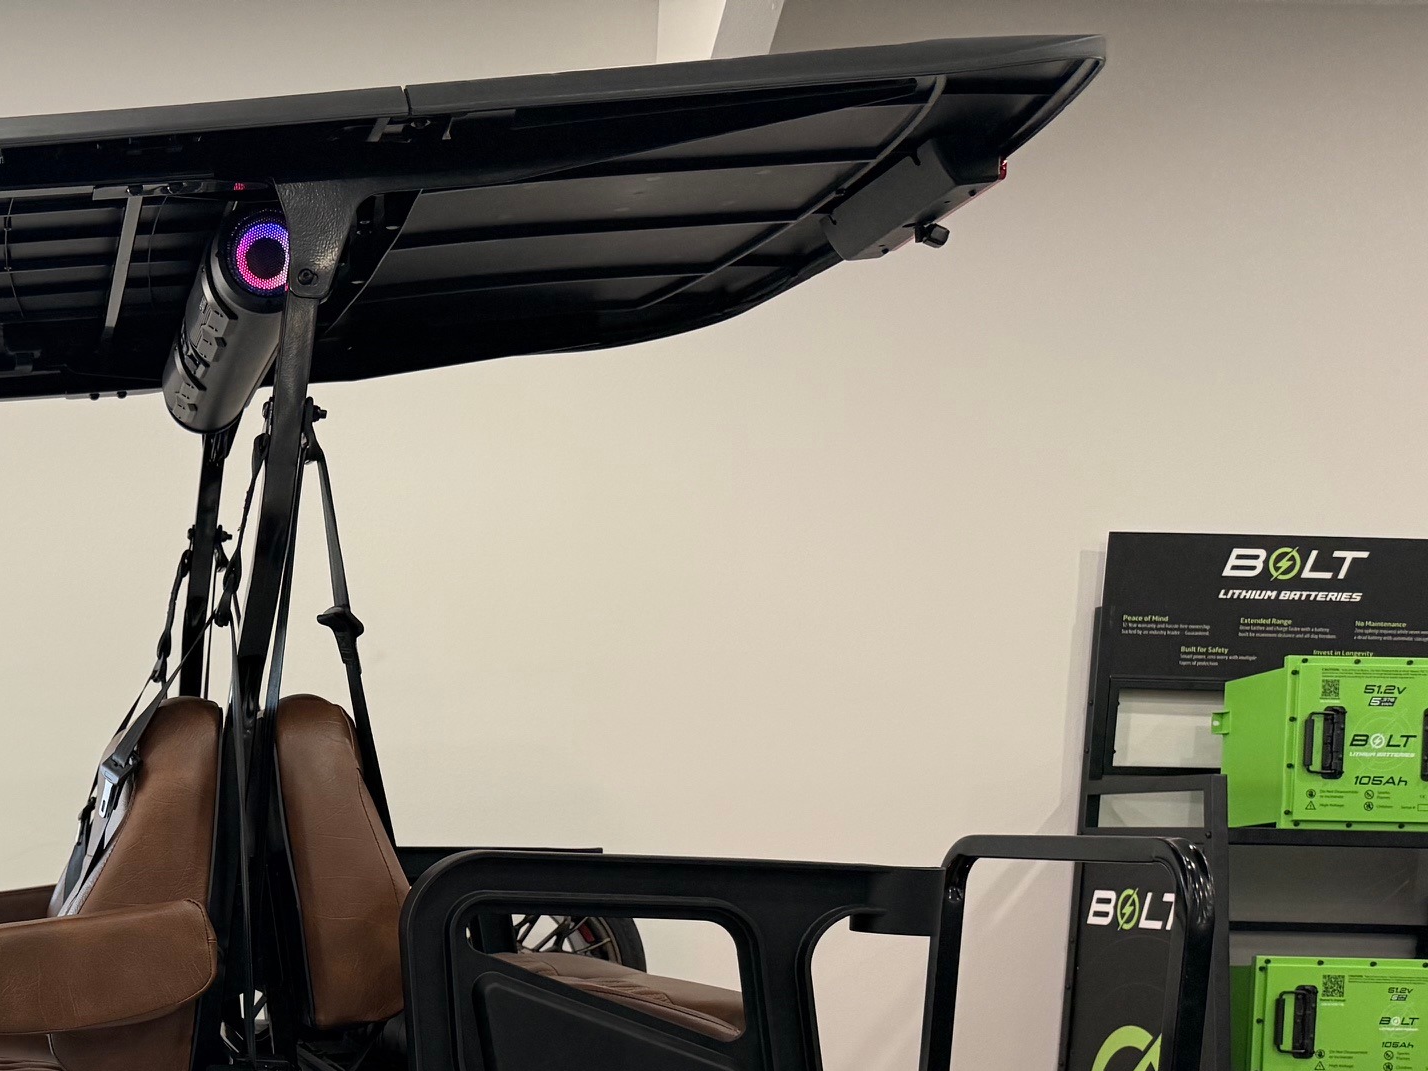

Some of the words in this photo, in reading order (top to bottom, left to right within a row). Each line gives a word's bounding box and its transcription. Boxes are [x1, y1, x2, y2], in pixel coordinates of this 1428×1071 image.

[1221, 546, 1370, 581] BOLT
[1218, 589, 1277, 600] LITHIUM
[1279, 590, 1363, 602] BATTERIES
[1272, 618, 1292, 626] Range
[1208, 646, 1229, 654] Safety
[1349, 733, 1417, 749] BOLT
[1354, 775, 1408, 786] 105Ah
[1087, 888, 1175, 930] BOLT
[1379, 1016, 1419, 1026] BOLT
